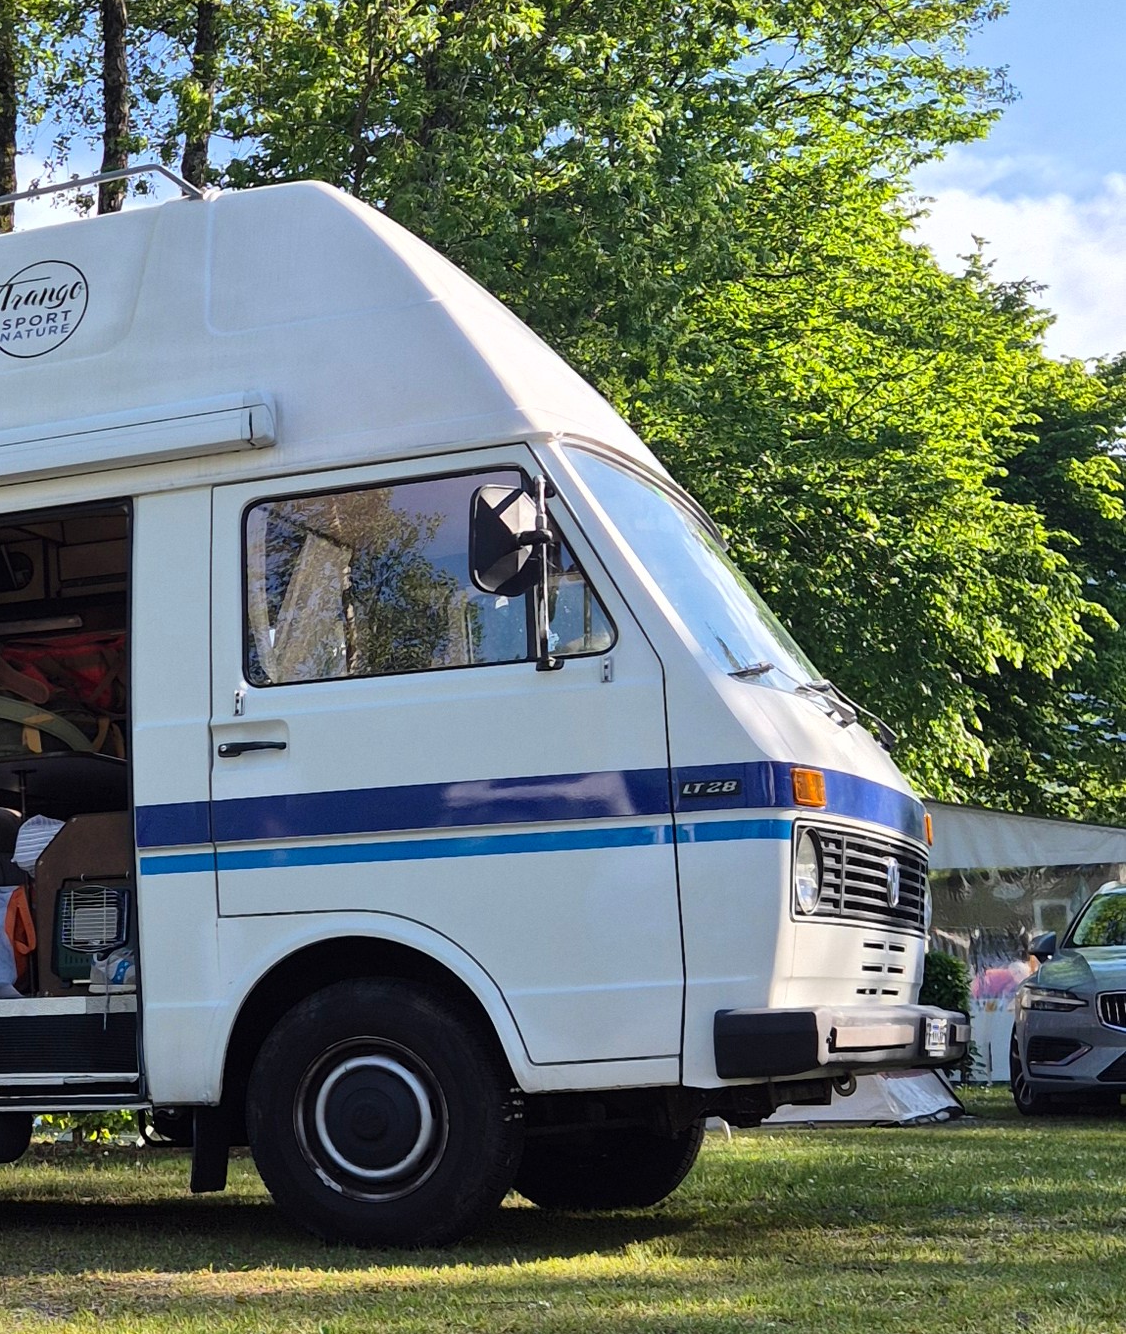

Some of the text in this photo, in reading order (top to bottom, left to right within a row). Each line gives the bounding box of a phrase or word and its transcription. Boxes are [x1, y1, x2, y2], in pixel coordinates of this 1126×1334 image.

[2, 310, 72, 330] SPORT
[0, 323, 70, 342] NATURE
[682, 781, 737, 794] LT 28
